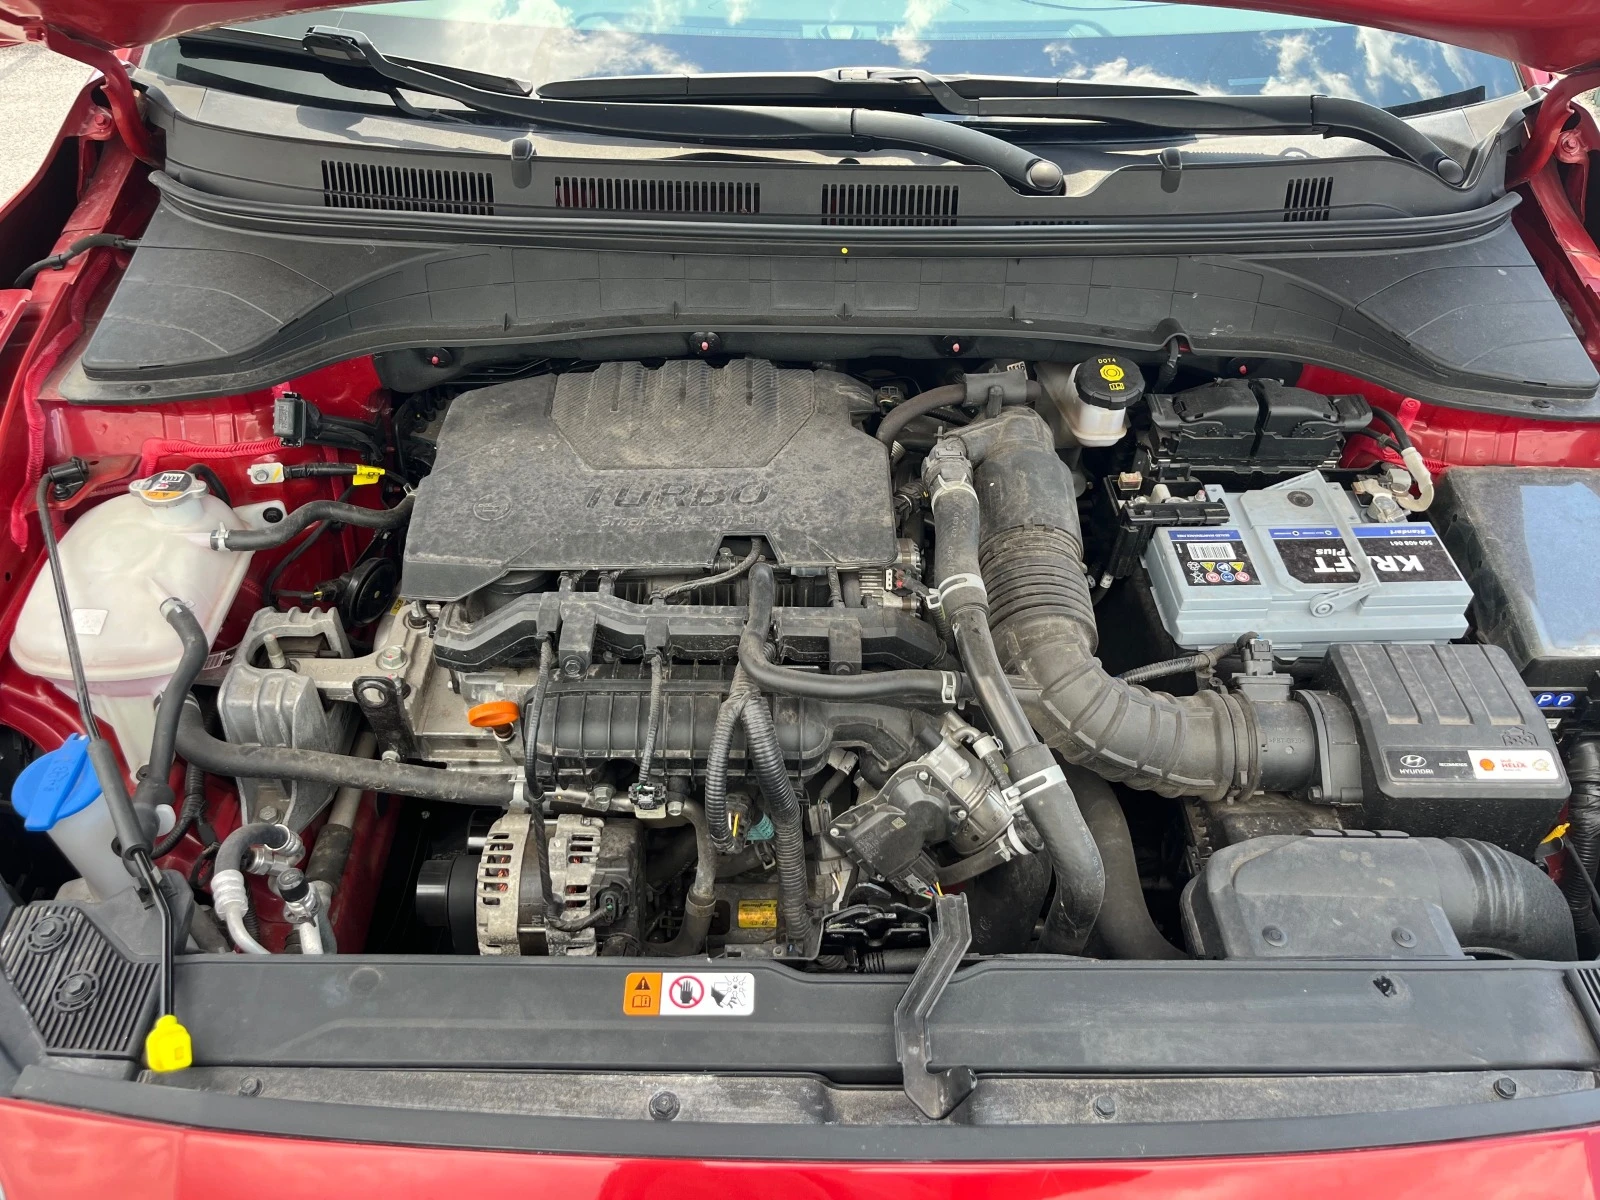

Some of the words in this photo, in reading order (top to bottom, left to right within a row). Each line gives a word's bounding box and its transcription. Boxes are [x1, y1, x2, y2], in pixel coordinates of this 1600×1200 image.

[584, 482, 771, 508] TURBO
[1315, 548, 1346, 557] Plus
[1313, 554, 1425, 573] KRFT
